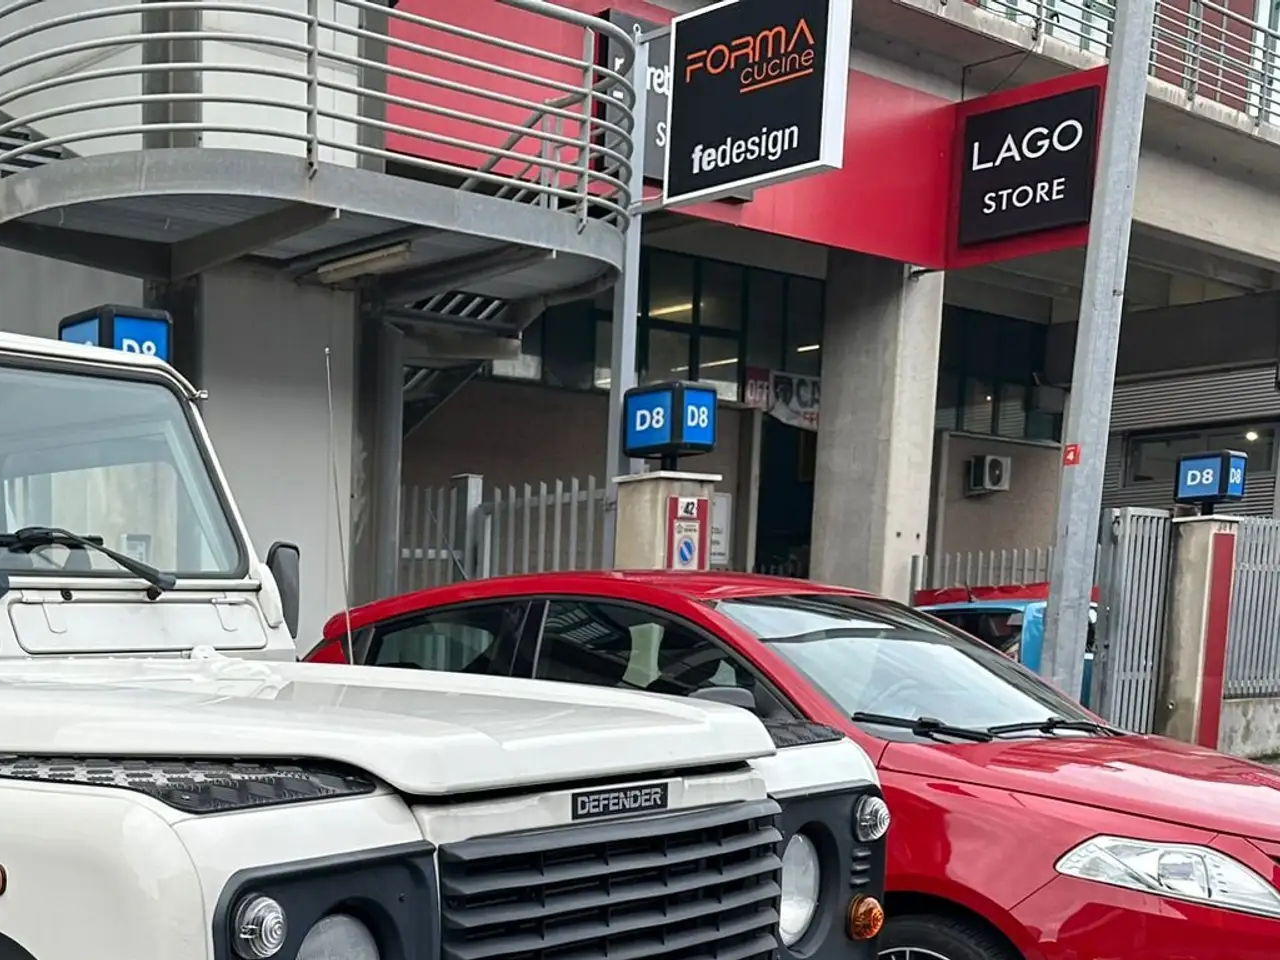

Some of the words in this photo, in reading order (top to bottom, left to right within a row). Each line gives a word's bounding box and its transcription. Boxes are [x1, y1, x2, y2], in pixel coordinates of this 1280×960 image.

[686, 18, 816, 83] FORMA
[740, 49, 814, 84] cucine
[692, 125, 799, 174] fedesign
[972, 119, 1083, 171] LAGO
[983, 178, 1066, 214] STORE
[635, 407, 665, 431] D8
[687, 405, 709, 427] D8
[1186, 468, 1213, 486] D8
[1229, 467, 1241, 484] D8
[577, 787, 662, 815] DEFENDER
